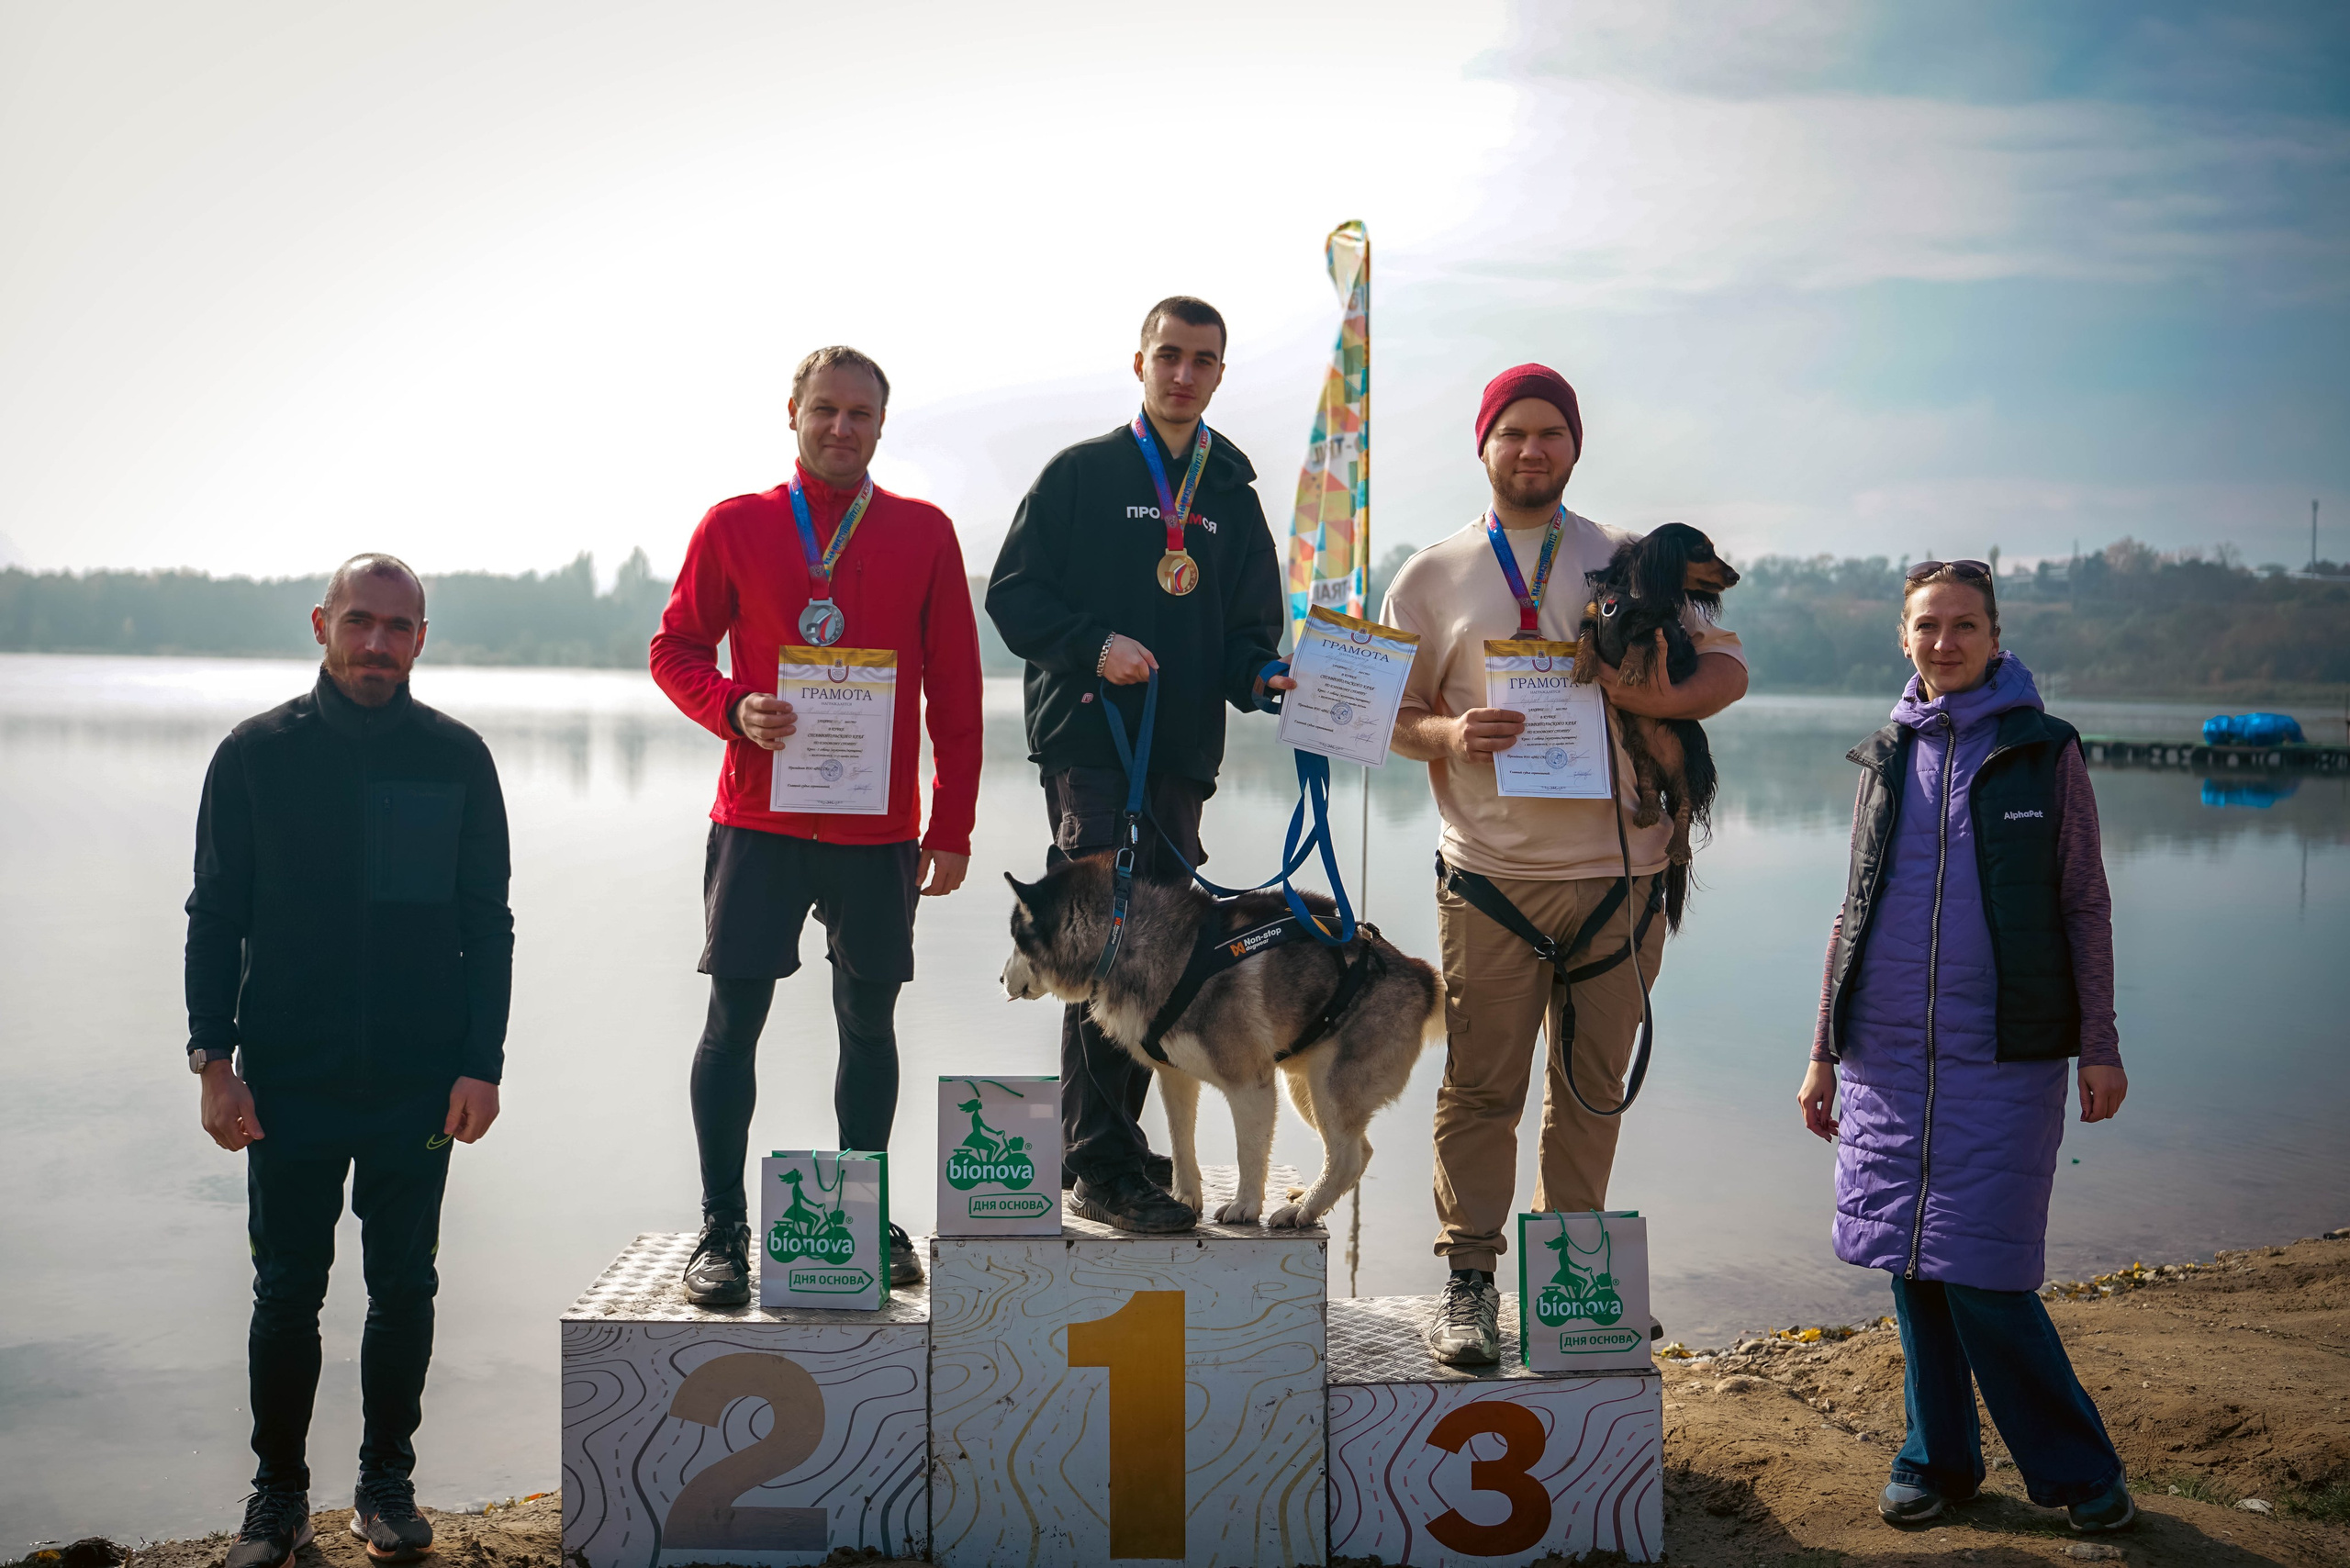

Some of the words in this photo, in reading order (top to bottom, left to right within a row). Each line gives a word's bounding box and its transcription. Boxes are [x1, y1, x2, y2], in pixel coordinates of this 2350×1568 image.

[1126, 506, 1218, 534] ПРОМСЯ
[1322, 639, 1390, 662] ГРАМОТА
[801, 687, 873, 701] ГРАМОТА
[2003, 810, 2043, 821] AlphaPet
[1244, 926, 1282, 946] Non-stop
[1245, 938, 1270, 952] dogwear
[948, 1159, 1035, 1181] bionova
[972, 1199, 998, 1213] ДНЯ
[998, 1199, 1046, 1212] ОСНОВА
[769, 1230, 855, 1255] bionova
[792, 1273, 817, 1287] ДНЯ
[818, 1273, 865, 1286] ОСНОВА
[1539, 1294, 1623, 1317] bionova
[1563, 1336, 1587, 1348] ДНЯ
[1589, 1334, 1633, 1346] ОСНОВА
[1068, 1291, 1185, 1559] 1
[662, 1352, 828, 1551] 2
[1425, 1401, 1553, 1557] 3
